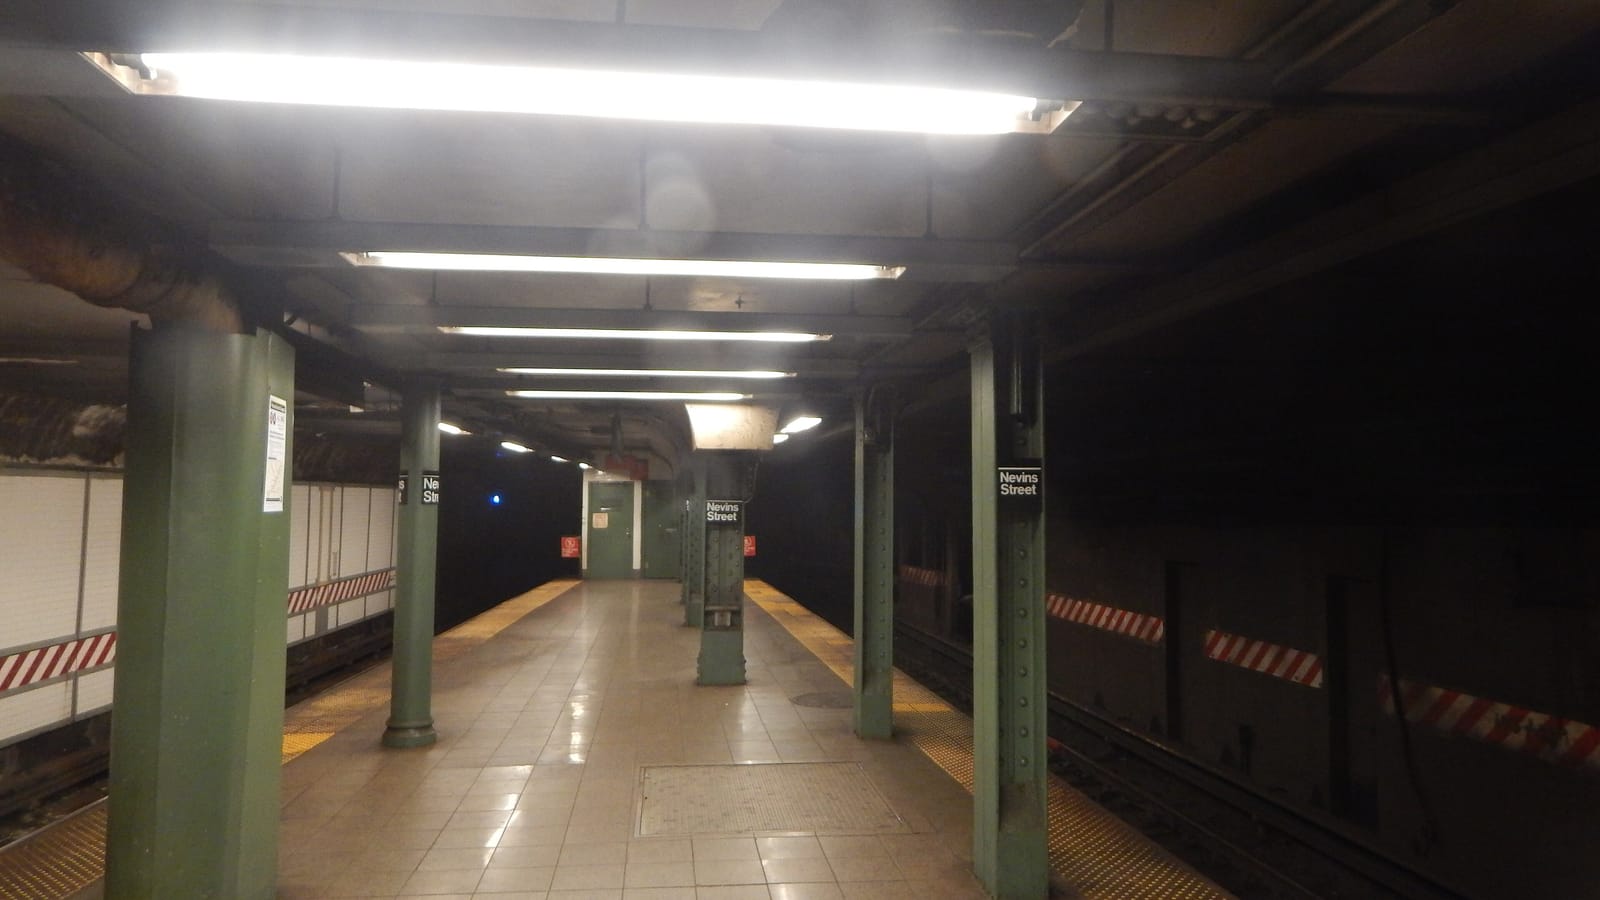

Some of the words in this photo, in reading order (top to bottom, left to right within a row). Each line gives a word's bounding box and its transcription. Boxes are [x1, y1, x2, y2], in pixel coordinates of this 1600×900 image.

[1000, 471, 1039, 483] Nevins
[1000, 483, 1037, 495] Street
[706, 502, 739, 512] Nevins
[706, 511, 737, 521] Street
